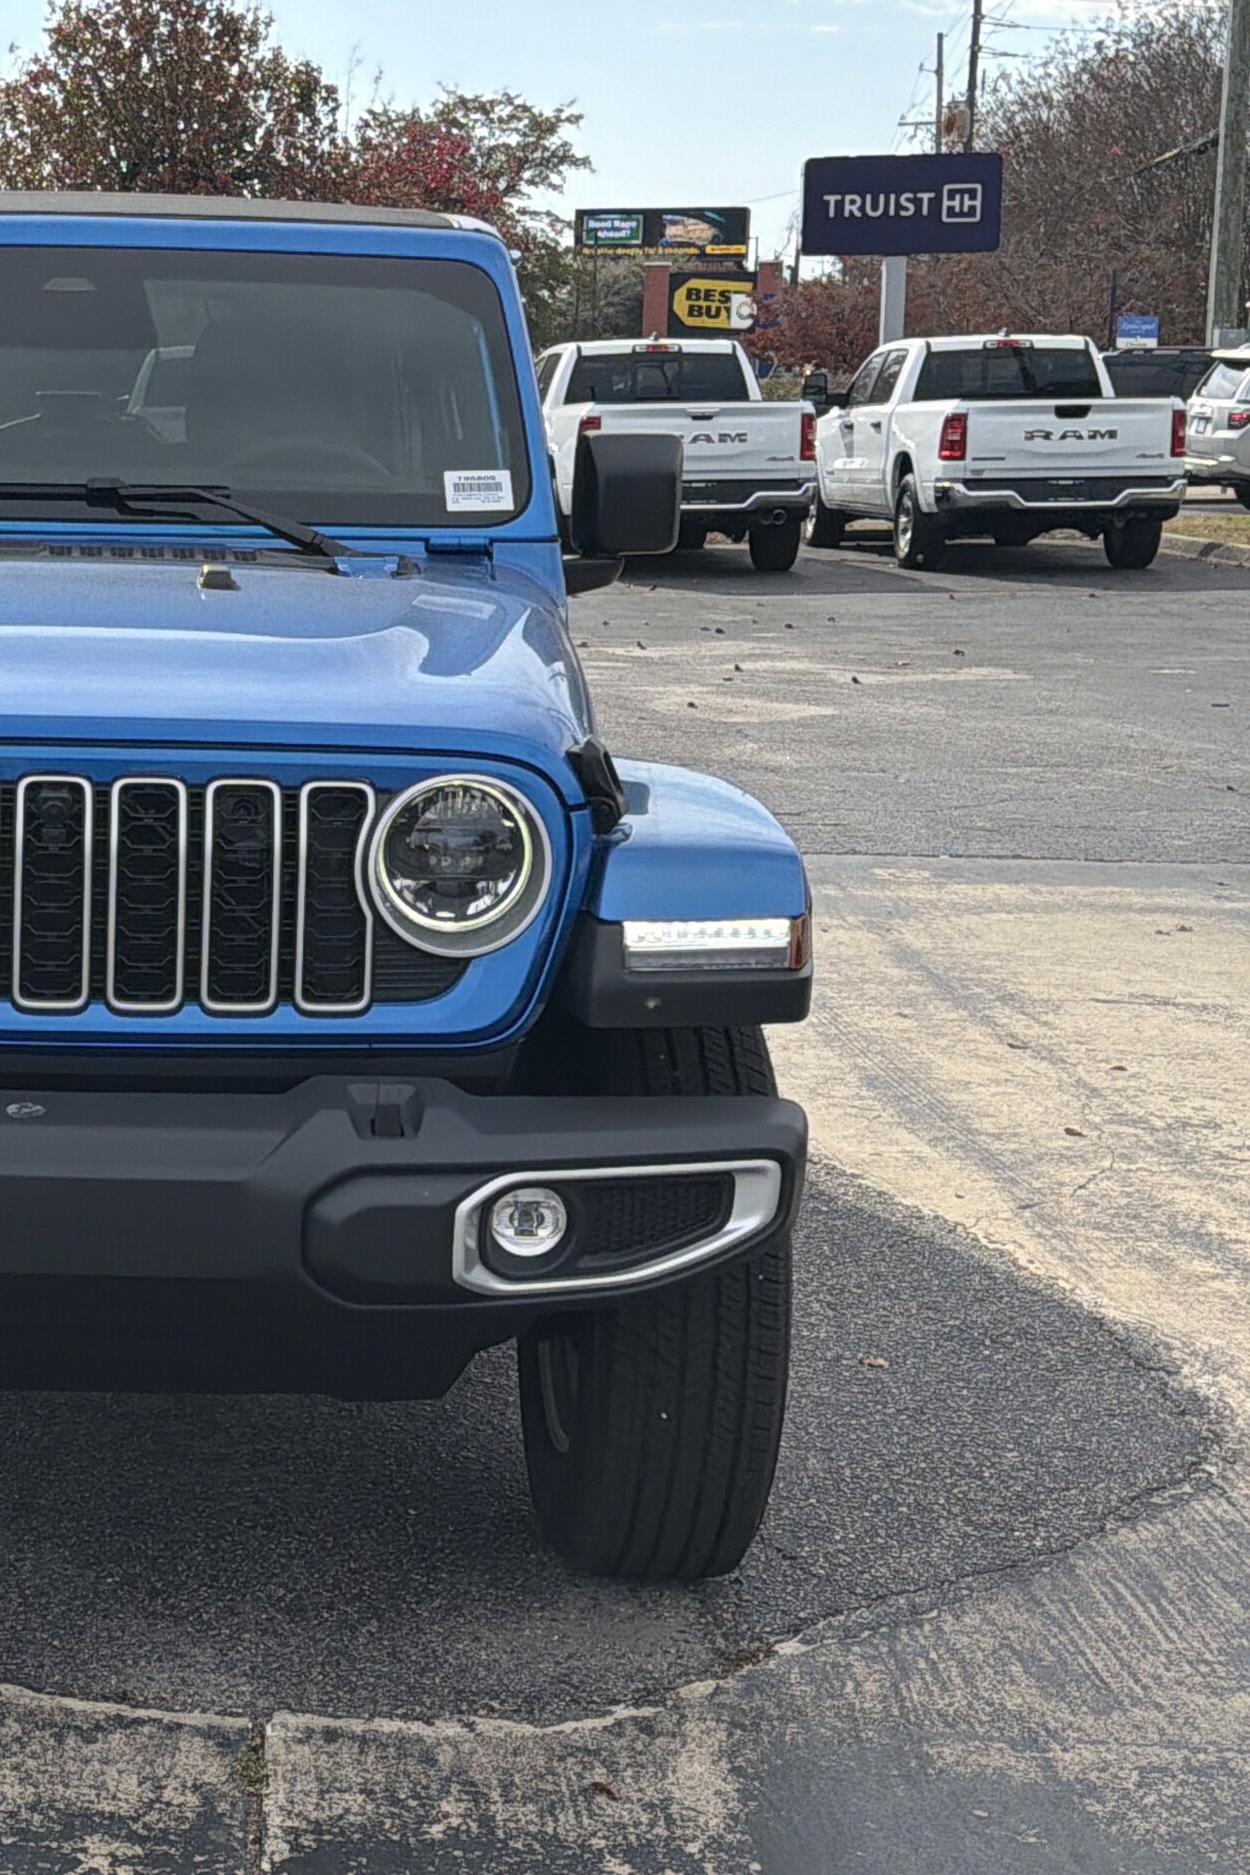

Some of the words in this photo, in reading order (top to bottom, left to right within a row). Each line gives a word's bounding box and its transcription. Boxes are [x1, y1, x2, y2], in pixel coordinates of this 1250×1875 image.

[823, 192, 935, 218] TRUIST
[686, 288, 750, 304] BES
[680, 432, 748, 444] AM
[1024, 429, 1118, 441] RAM
